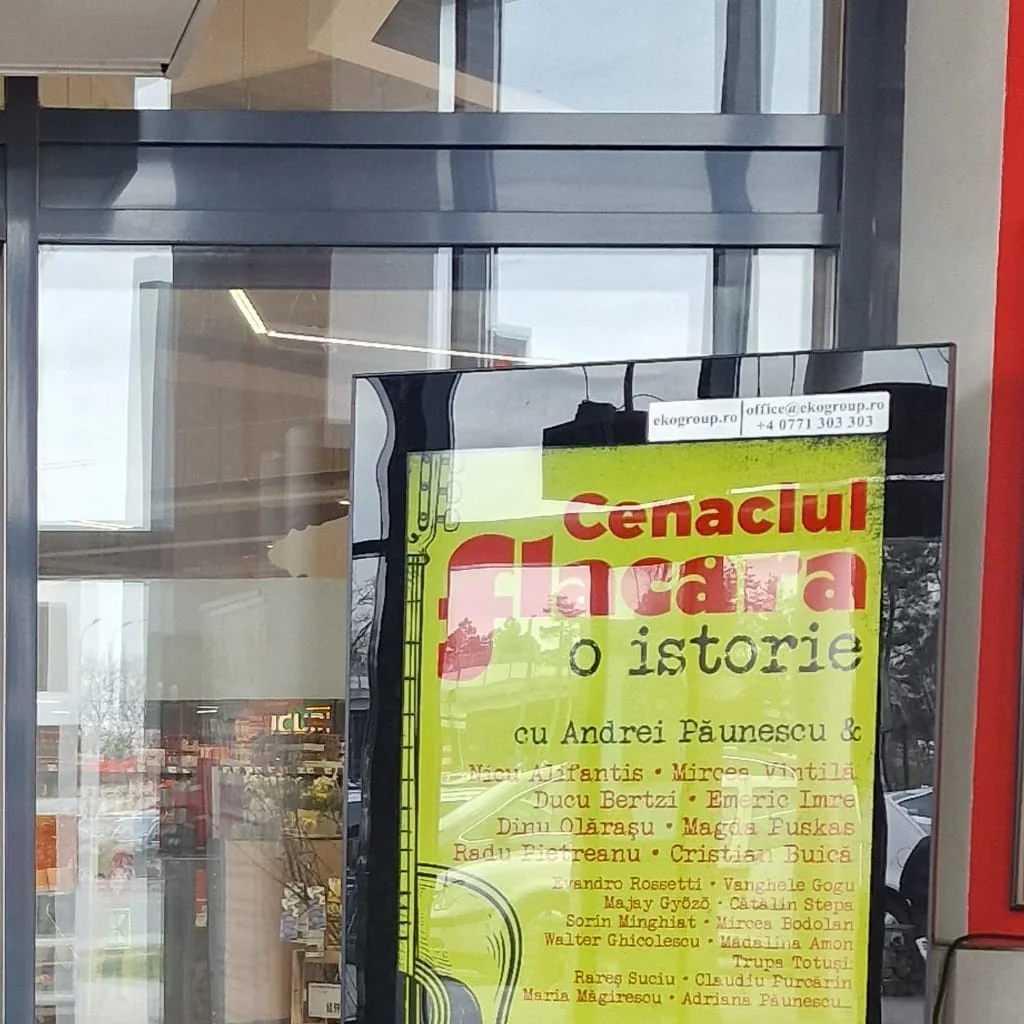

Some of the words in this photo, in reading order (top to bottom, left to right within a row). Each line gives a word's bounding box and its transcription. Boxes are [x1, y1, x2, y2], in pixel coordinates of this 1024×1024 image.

[746, 399, 884, 416] office@ekogroup.ro
[653, 412, 738, 427] ekogroup.ro
[756, 418, 774, 431] +4
[779, 418, 812, 431] 0771
[817, 416, 843, 429] 303
[848, 415, 874, 428] 303
[563, 480, 868, 540] Cenaclul
[569, 638, 602, 677] o
[628, 622, 863, 677] istorie
[514, 725, 548, 745] cu
[561, 720, 666, 745] Andrei
[679, 718, 826, 744] Păunescu
[468, 764, 519, 783] Nicu
[529, 763, 644, 783] Alifantis
[672, 762, 750, 783] Mircea
[763, 762, 856, 782] Vintilă
[533, 790, 590, 809] Ducu
[600, 790, 678, 809] Bertzi
[706, 789, 790, 809] Emeric
[799, 789, 856, 809] Imre
[496, 816, 550, 836] Dinu
[682, 816, 759, 840] Magda
[767, 816, 856, 836] Puskas
[453, 842, 512, 862] Radu
[521, 843, 641, 863] Pietreanu
[670, 843, 777, 863] Cristian
[783, 843, 853, 863] Buică
[552, 876, 623, 891] Evandro
[630, 876, 703, 891] Rossetti
[723, 877, 805, 895] Vanghele
[812, 877, 855, 895] Gogu
[604, 895, 654, 912] Majay
[566, 913, 612, 928] Sorin
[619, 913, 697, 931] Minghiat
[716, 915, 773, 930] Mircea
[781, 915, 854, 931] Bodolan
[544, 932, 602, 947] Walter
[607, 933, 700, 948] Ghicolescu
[809, 936, 854, 951] Amon
[733, 954, 784, 972] Trupa
[628, 971, 675, 986] Suciu
[695, 973, 764, 988] Claudiu
[523, 987, 570, 1002] Maria
[682, 991, 753, 1006] Adriana
